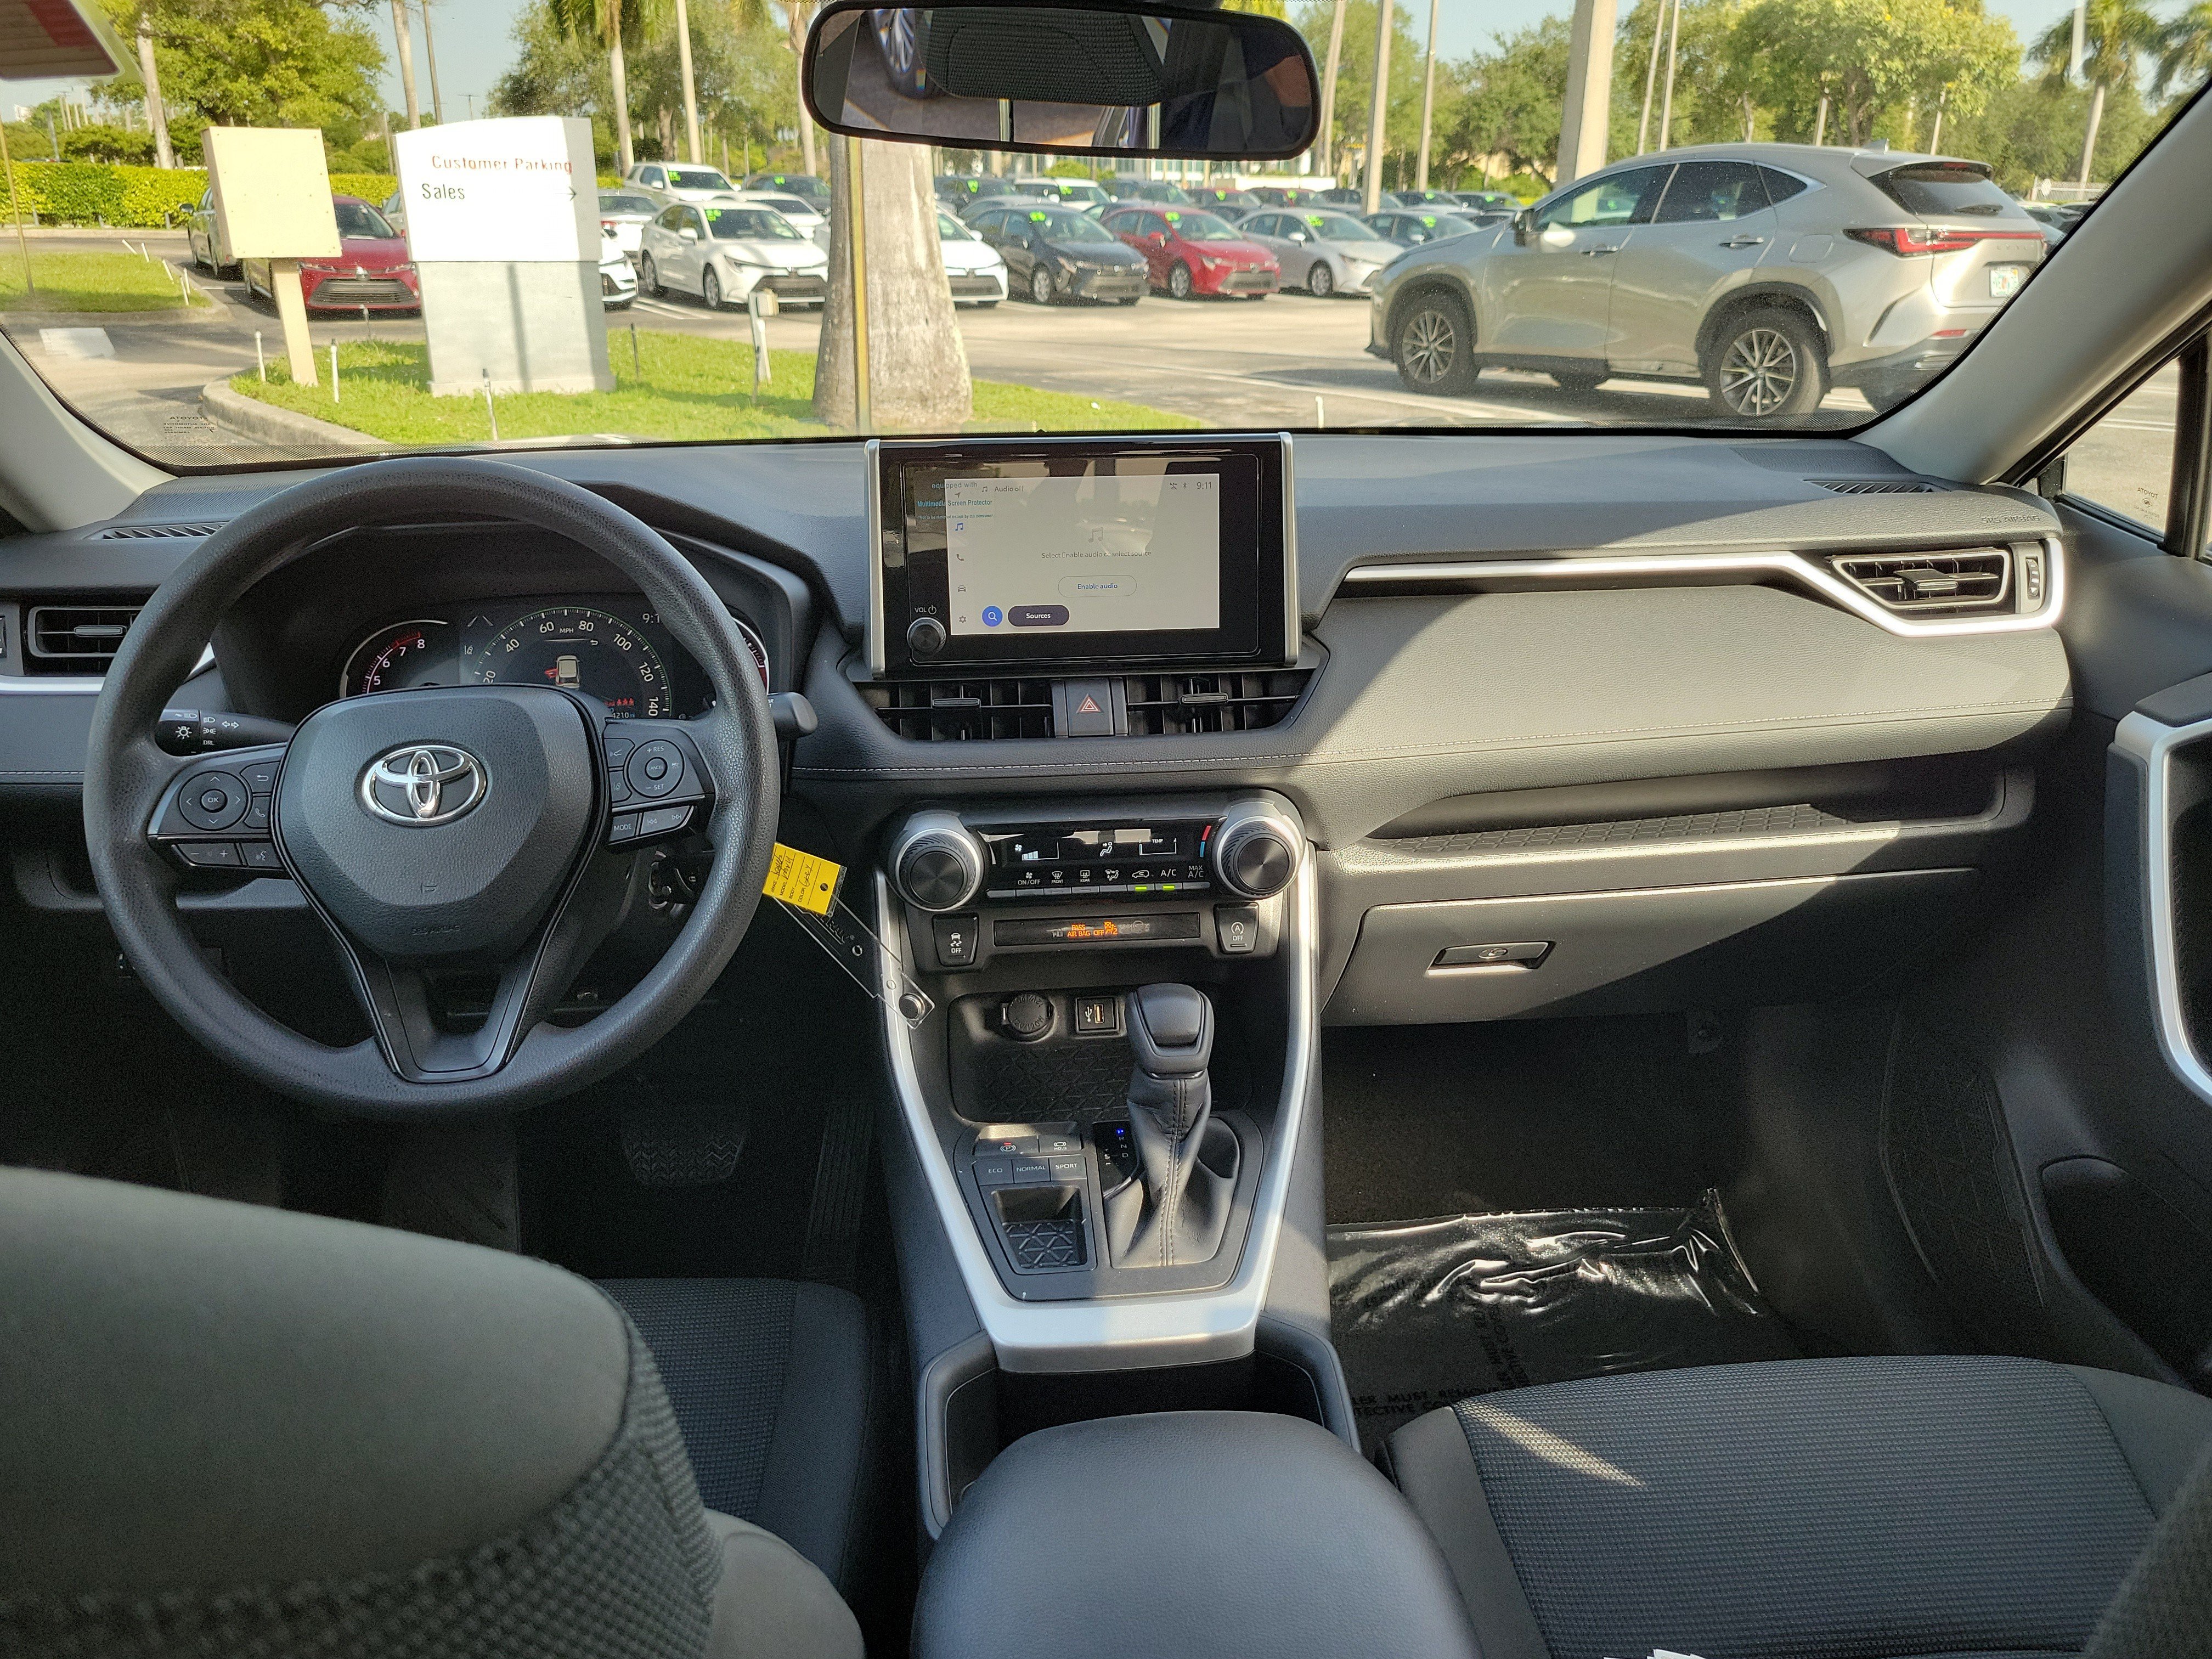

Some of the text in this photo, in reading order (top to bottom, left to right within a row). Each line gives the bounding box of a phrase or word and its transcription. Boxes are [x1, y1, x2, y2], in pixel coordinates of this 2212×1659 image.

[431, 155, 573, 174] Customer Parking
[421, 183, 466, 200] Sales
[1196, 481, 1212, 489] 9:11
[642, 613, 660, 623] 9:1
[540, 621, 554, 633] 60
[579, 620, 594, 631] 80
[417, 639, 425, 648] 8
[506, 639, 520, 653] 40
[613, 633, 632, 651] 100
[399, 647, 407, 656] 7
[382, 658, 390, 668] 6
[483, 670, 496, 684] 20
[639, 662, 654, 682] 120
[374, 675, 381, 685] 5
[648, 697, 659, 716] 140
[1160, 869, 1177, 877] A/C
[780, 881, 788, 896] MODEL
[1355, 1403, 1415, 1417] TECTIVE
